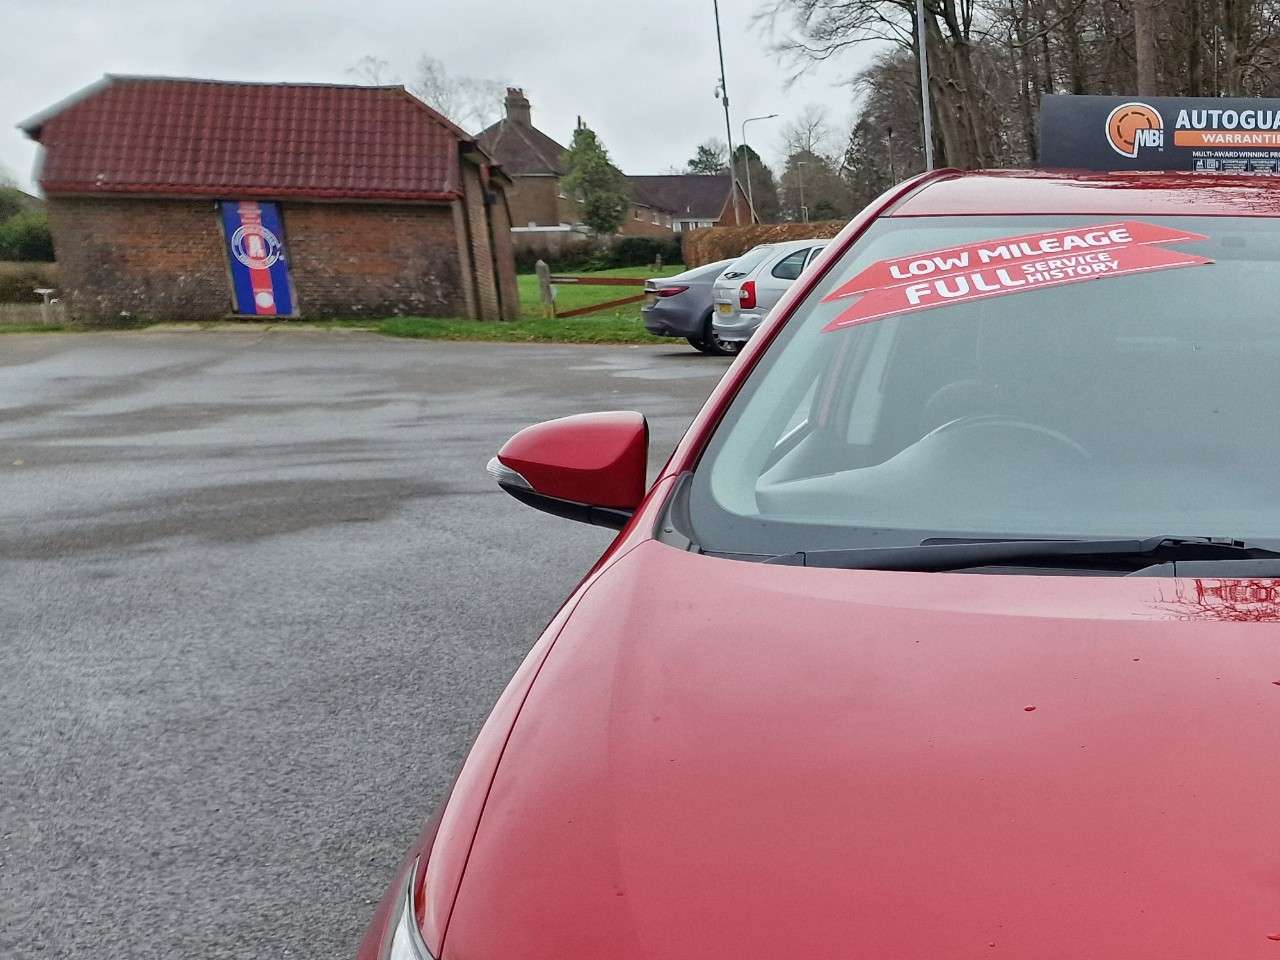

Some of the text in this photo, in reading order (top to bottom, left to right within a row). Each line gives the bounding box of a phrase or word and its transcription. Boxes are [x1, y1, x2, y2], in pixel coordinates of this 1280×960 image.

[888, 228, 1133, 280] LOW MILEAGE
[1021, 252, 1112, 274] SERVICE
[905, 267, 1026, 304] FULL
[1027, 260, 1121, 284] HISTORY
